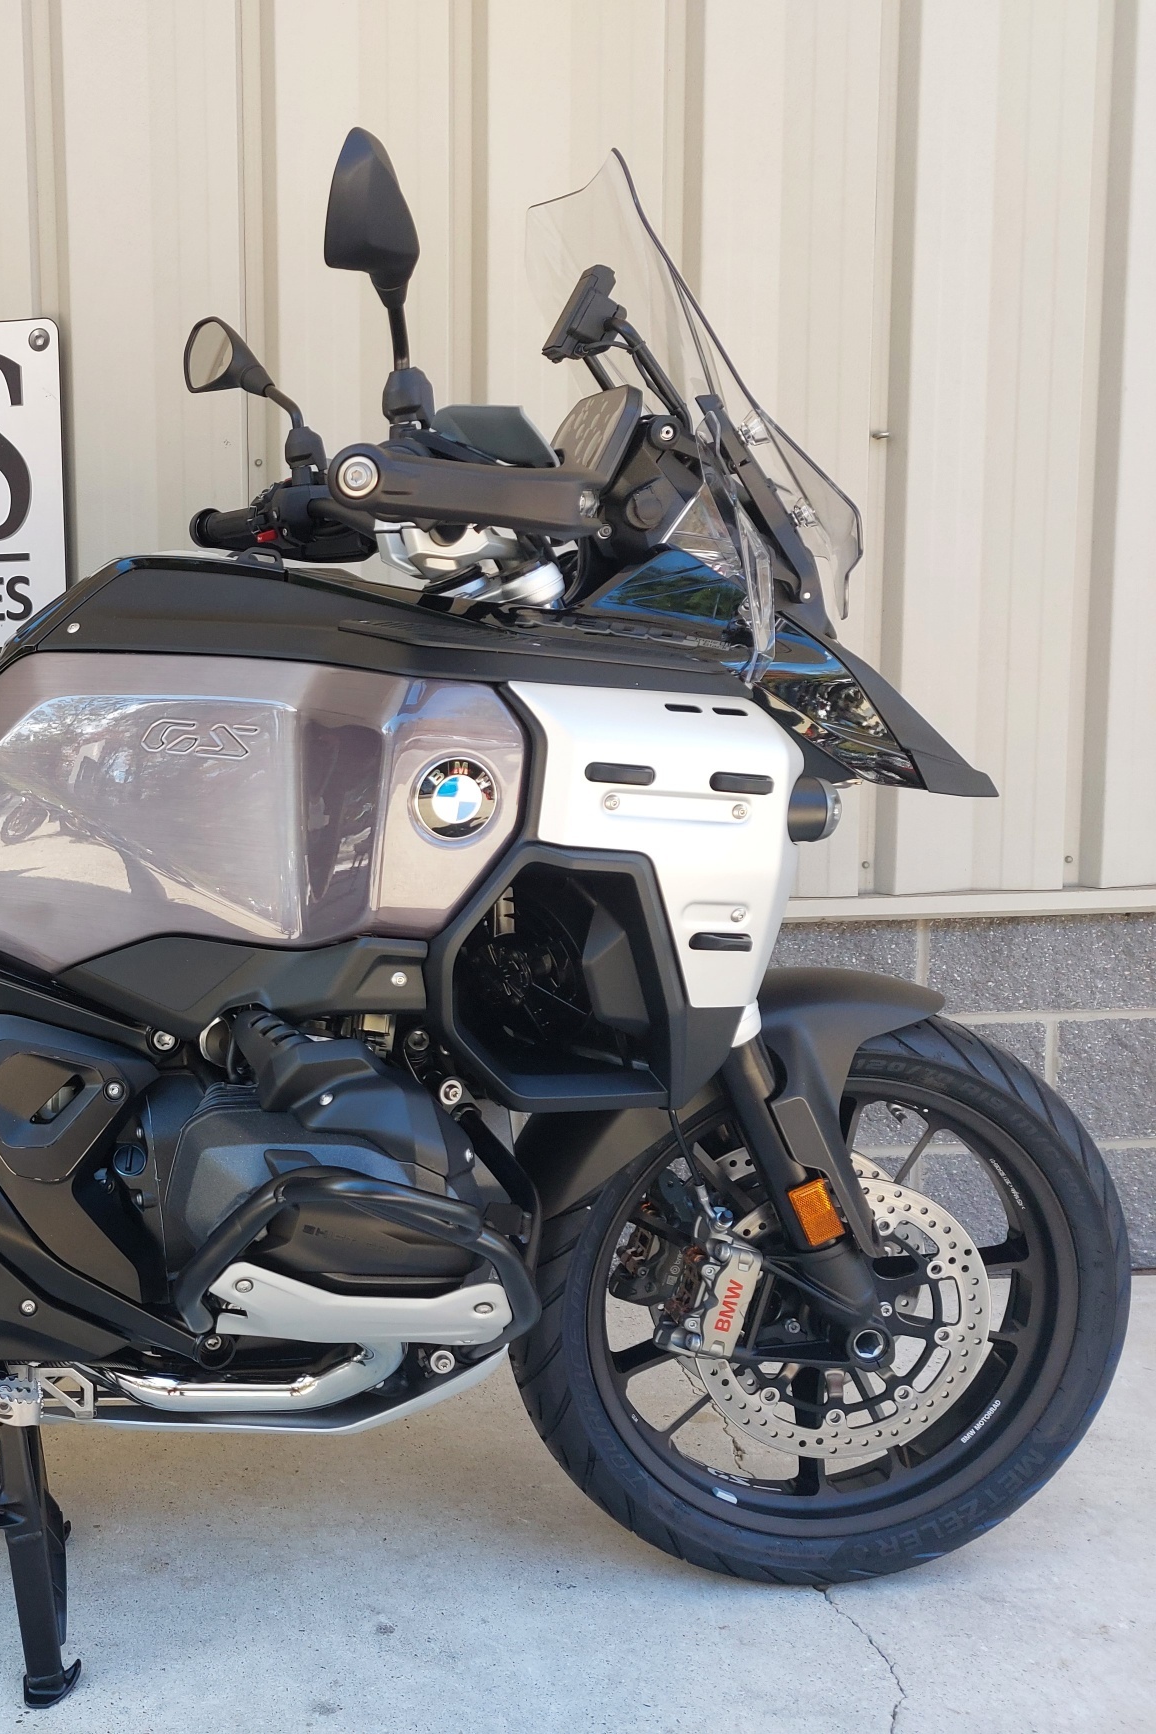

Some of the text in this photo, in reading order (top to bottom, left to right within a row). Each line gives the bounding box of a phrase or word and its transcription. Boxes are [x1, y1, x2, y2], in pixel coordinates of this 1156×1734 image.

[141, 718, 259, 760] GS
[428, 761, 492, 790] BMW
[714, 1279, 743, 1332] BMW
[960, 1399, 1001, 1443] BMW MOTORRAD
[875, 1448, 1047, 1557] METZELER
